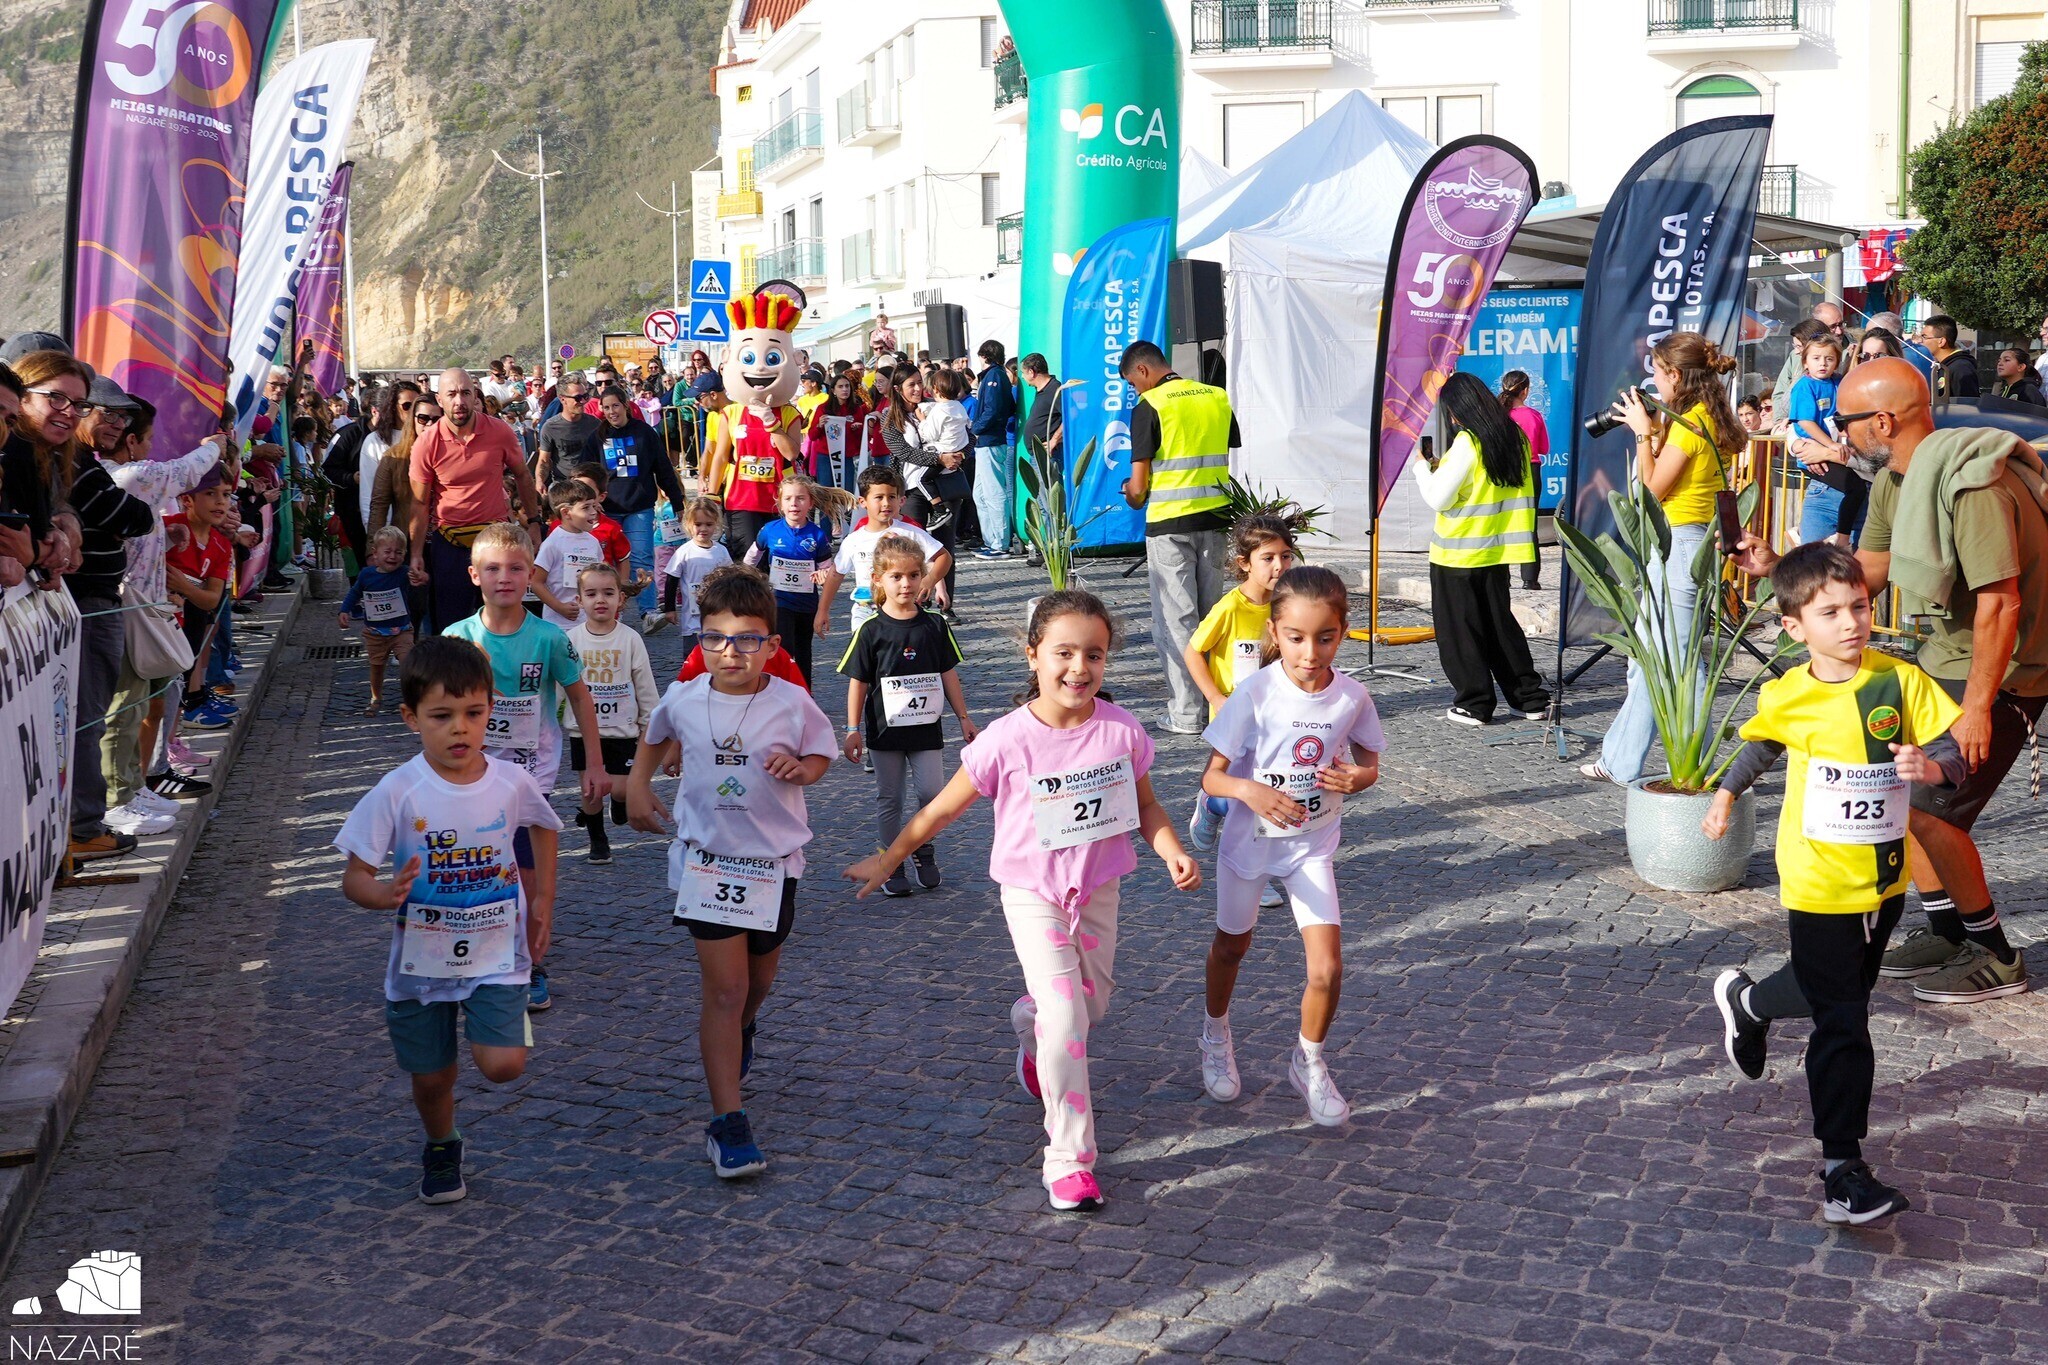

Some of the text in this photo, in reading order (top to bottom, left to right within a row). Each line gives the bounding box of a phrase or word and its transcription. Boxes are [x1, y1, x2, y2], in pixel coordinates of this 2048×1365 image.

[104, 0, 252, 108] 50
[184, 44, 228, 66] ANOS
[110, 98, 233, 135] MEIAS MARATONAS
[168, 122, 190, 135] 1975
[197, 128, 219, 141] 2025
[1114, 104, 1168, 149] CA
[1076, 154, 1167, 171] Crédito Agrícola
[1427, 181, 1509, 247] MEIA MARATONA INTERNACIONAL
[1684, 243, 1709, 317] LOTAS,
[1702, 211, 1716, 237] S.A.
[1873, 249, 1882, 268] 7
[1406, 252, 1484, 310] 50
[1447, 278, 1470, 286] ANOS
[1481, 296, 1569, 308] S SEUS CLIENTES
[1640, 212, 1689, 400] OCAPESCA
[1410, 310, 1434, 318] MEIAS
[1496, 311, 1545, 324] TAMBÉM
[606, 339, 634, 349] LITTLE
[1104, 279, 1123, 411] DOCAPESCA
[1463, 326, 1579, 356] LERAM!
[1166, 388, 1214, 399] ORGANIZAÇÃO
[741, 465, 773, 477] 1987
[830, 451, 842, 487] EIA
[200, 558, 210, 577] 9
[785, 573, 799, 583] 36
[374, 603, 393, 612] 138
[583, 650, 622, 668] JUST
[522, 664, 541, 678] RS
[587, 669, 614, 684] DO
[904, 676, 938, 685] DOCAPESCA
[494, 699, 532, 707] CAPESCA
[594, 702, 618, 714] 101
[908, 696, 928, 710] 47
[486, 718, 510, 733] 62
[1292, 721, 1332, 730] GIVOVA
[715, 754, 749, 766] BEST
[1065, 762, 1122, 784] DOCAPESCA
[1847, 767, 1898, 779] DOCAPESC
[1067, 782, 1091, 791] PORTOS
[1097, 776, 1116, 786] LOTAS,
[1075, 787, 1097, 797] FUTURO
[1097, 779, 1128, 792] DOCAPESCA
[1878, 784, 1906, 793] DOCAPESCA
[1074, 798, 1102, 822] 27
[1309, 808, 1331, 821] ERREIRA
[1841, 799, 1885, 819] 123
[1086, 817, 1118, 830] BARBOSA
[1855, 822, 1894, 830] RODRIGUES
[425, 829, 457, 849] 19
[428, 845, 494, 869] MEIA
[718, 855, 775, 870] DOCAPESCA
[1888, 852, 1898, 866] G
[428, 863, 502, 884] FUTURO
[717, 864, 741, 873] PORTOS
[747, 869, 766, 877] LOTAS,
[723, 871, 744, 880] FUTURO
[745, 875, 777, 884] DOCAPESCA
[436, 880, 492, 894] DOCAPESCA
[715, 882, 747, 904] 33
[446, 906, 505, 921] DOCAPESCA
[700, 902, 754, 916] MATIAS ROCHA
[445, 921, 471, 929] PORTOS
[477, 919, 496, 927] LOTAS,
[476, 923, 509, 933] DOCAPESCA
[453, 940, 470, 958] 6
